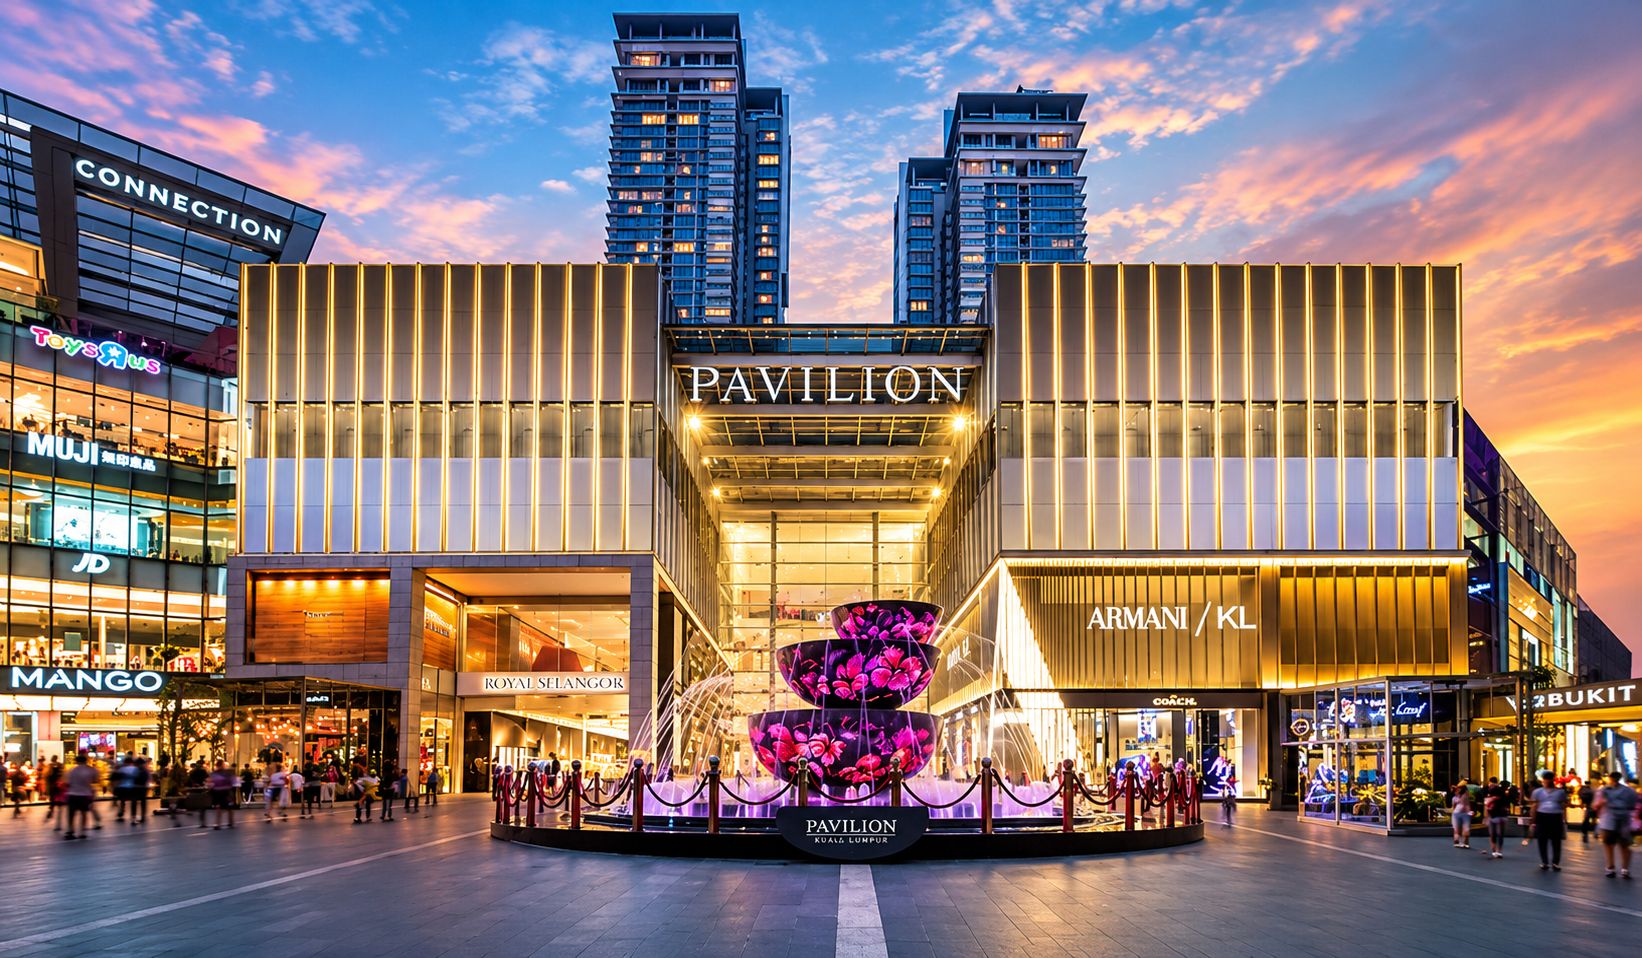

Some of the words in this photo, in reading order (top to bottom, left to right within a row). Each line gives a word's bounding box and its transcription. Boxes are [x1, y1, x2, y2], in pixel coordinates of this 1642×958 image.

[75, 159, 282, 245] CONNECTION
[690, 366, 964, 403] PAVILION
[27, 430, 99, 465] MUJI
[72, 553, 110, 574] JD
[1087, 606, 1188, 630] ARMANI
[1217, 605, 1257, 630] KL
[11, 666, 163, 692] MANGO
[484, 677, 534, 689] ROYAL
[537, 677, 624, 689] SELANGOR
[806, 819, 897, 833] PAVILION
[814, 836, 845, 844] KUALA
[848, 836, 888, 844] LUMPUR
